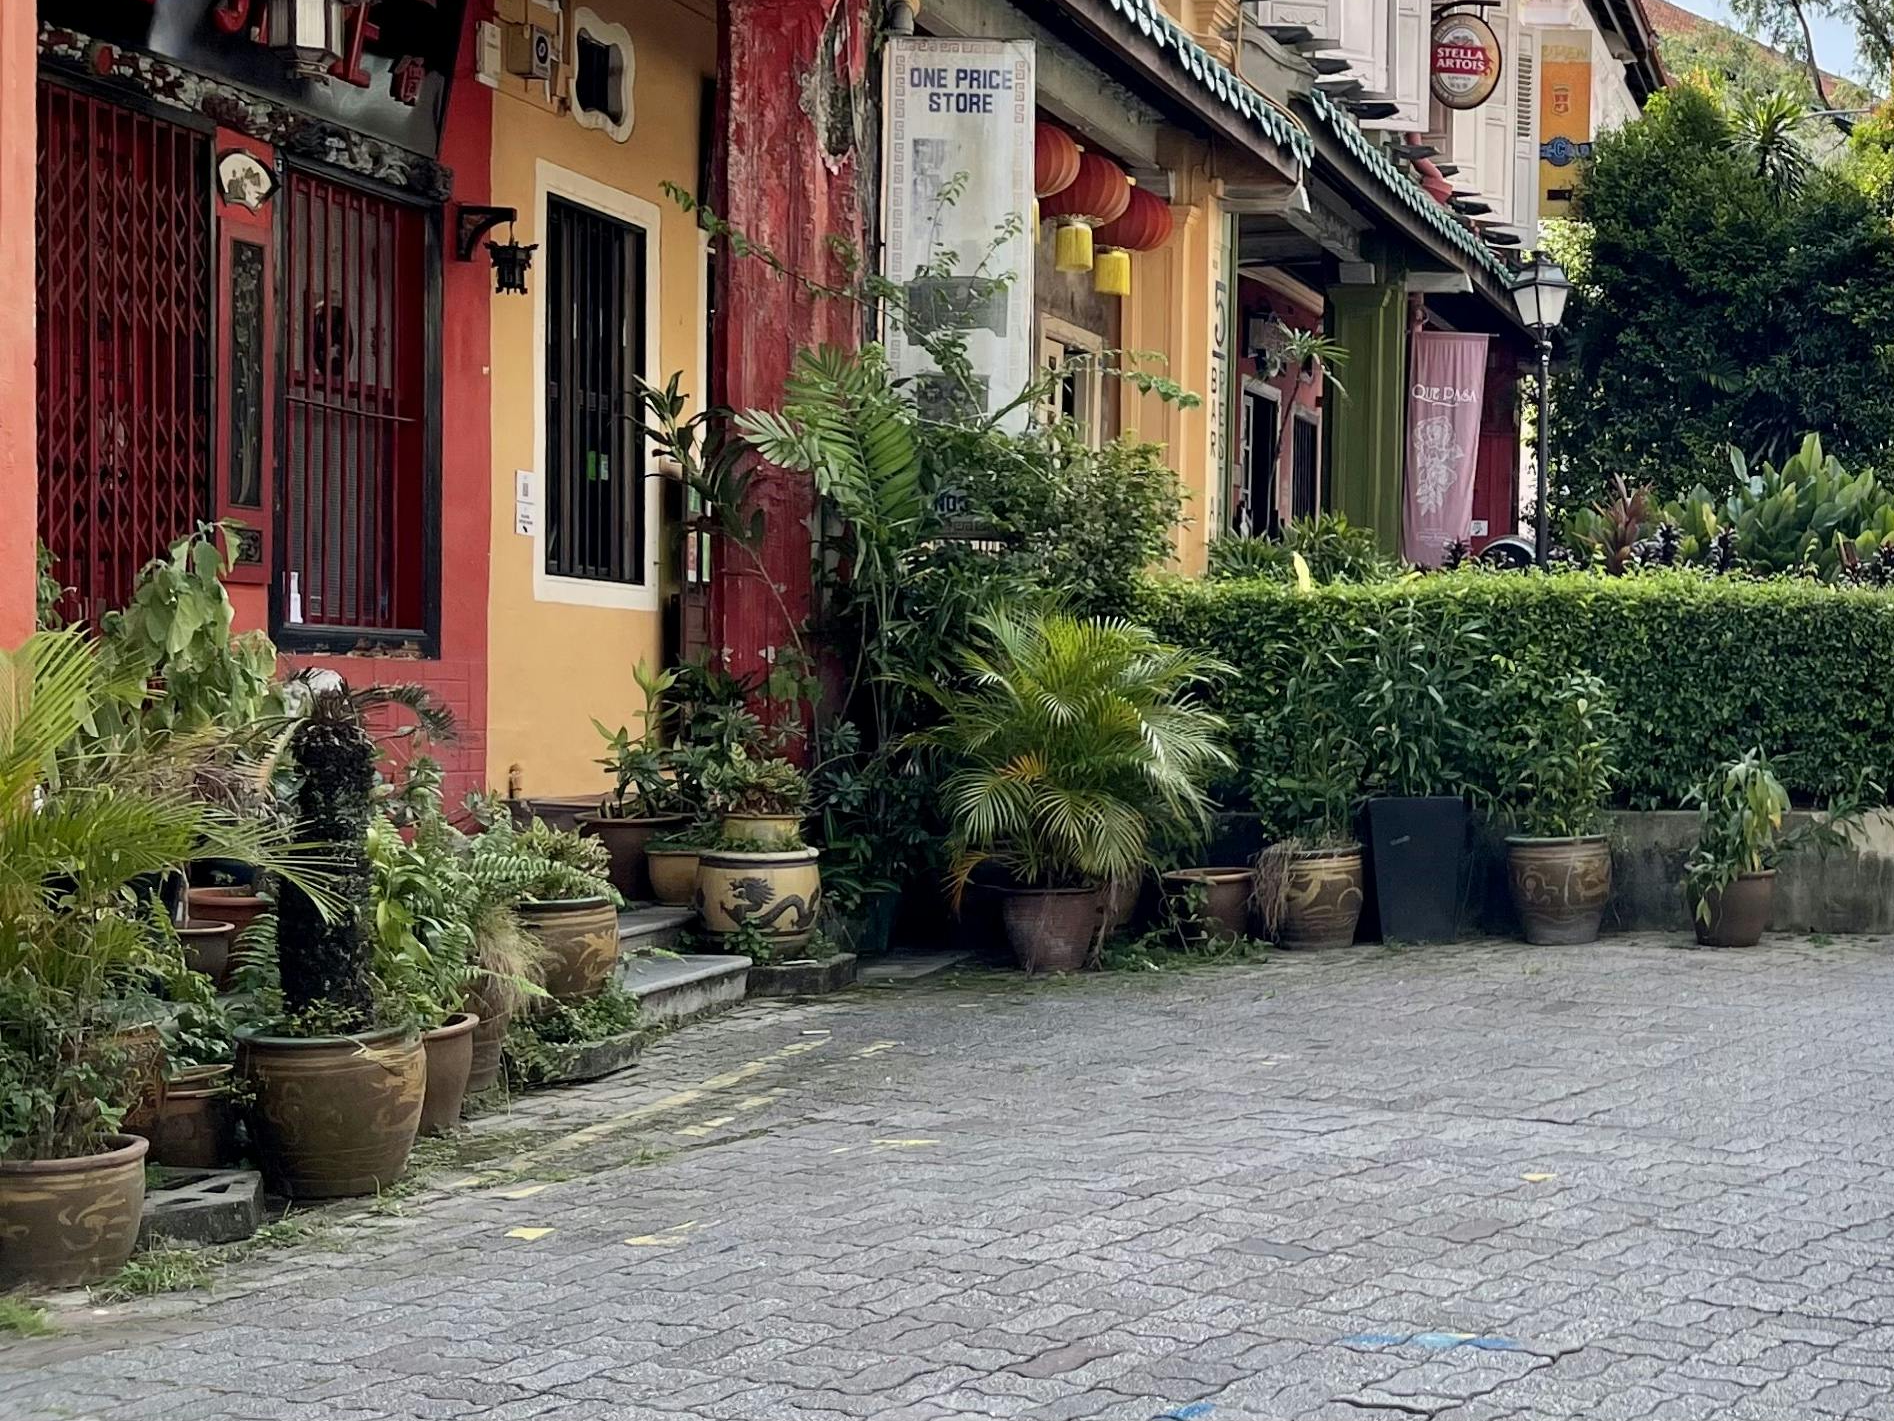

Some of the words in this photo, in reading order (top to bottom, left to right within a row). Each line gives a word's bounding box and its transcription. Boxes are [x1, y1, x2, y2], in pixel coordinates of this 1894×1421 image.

[1437, 46, 1484, 61] STELLA
[1436, 58, 1486, 72] ARTOIS
[910, 67, 948, 89] ONE
[955, 68, 1013, 91] PRICE
[928, 92, 993, 114] STORE
[1209, 366, 1218, 459] BAR
